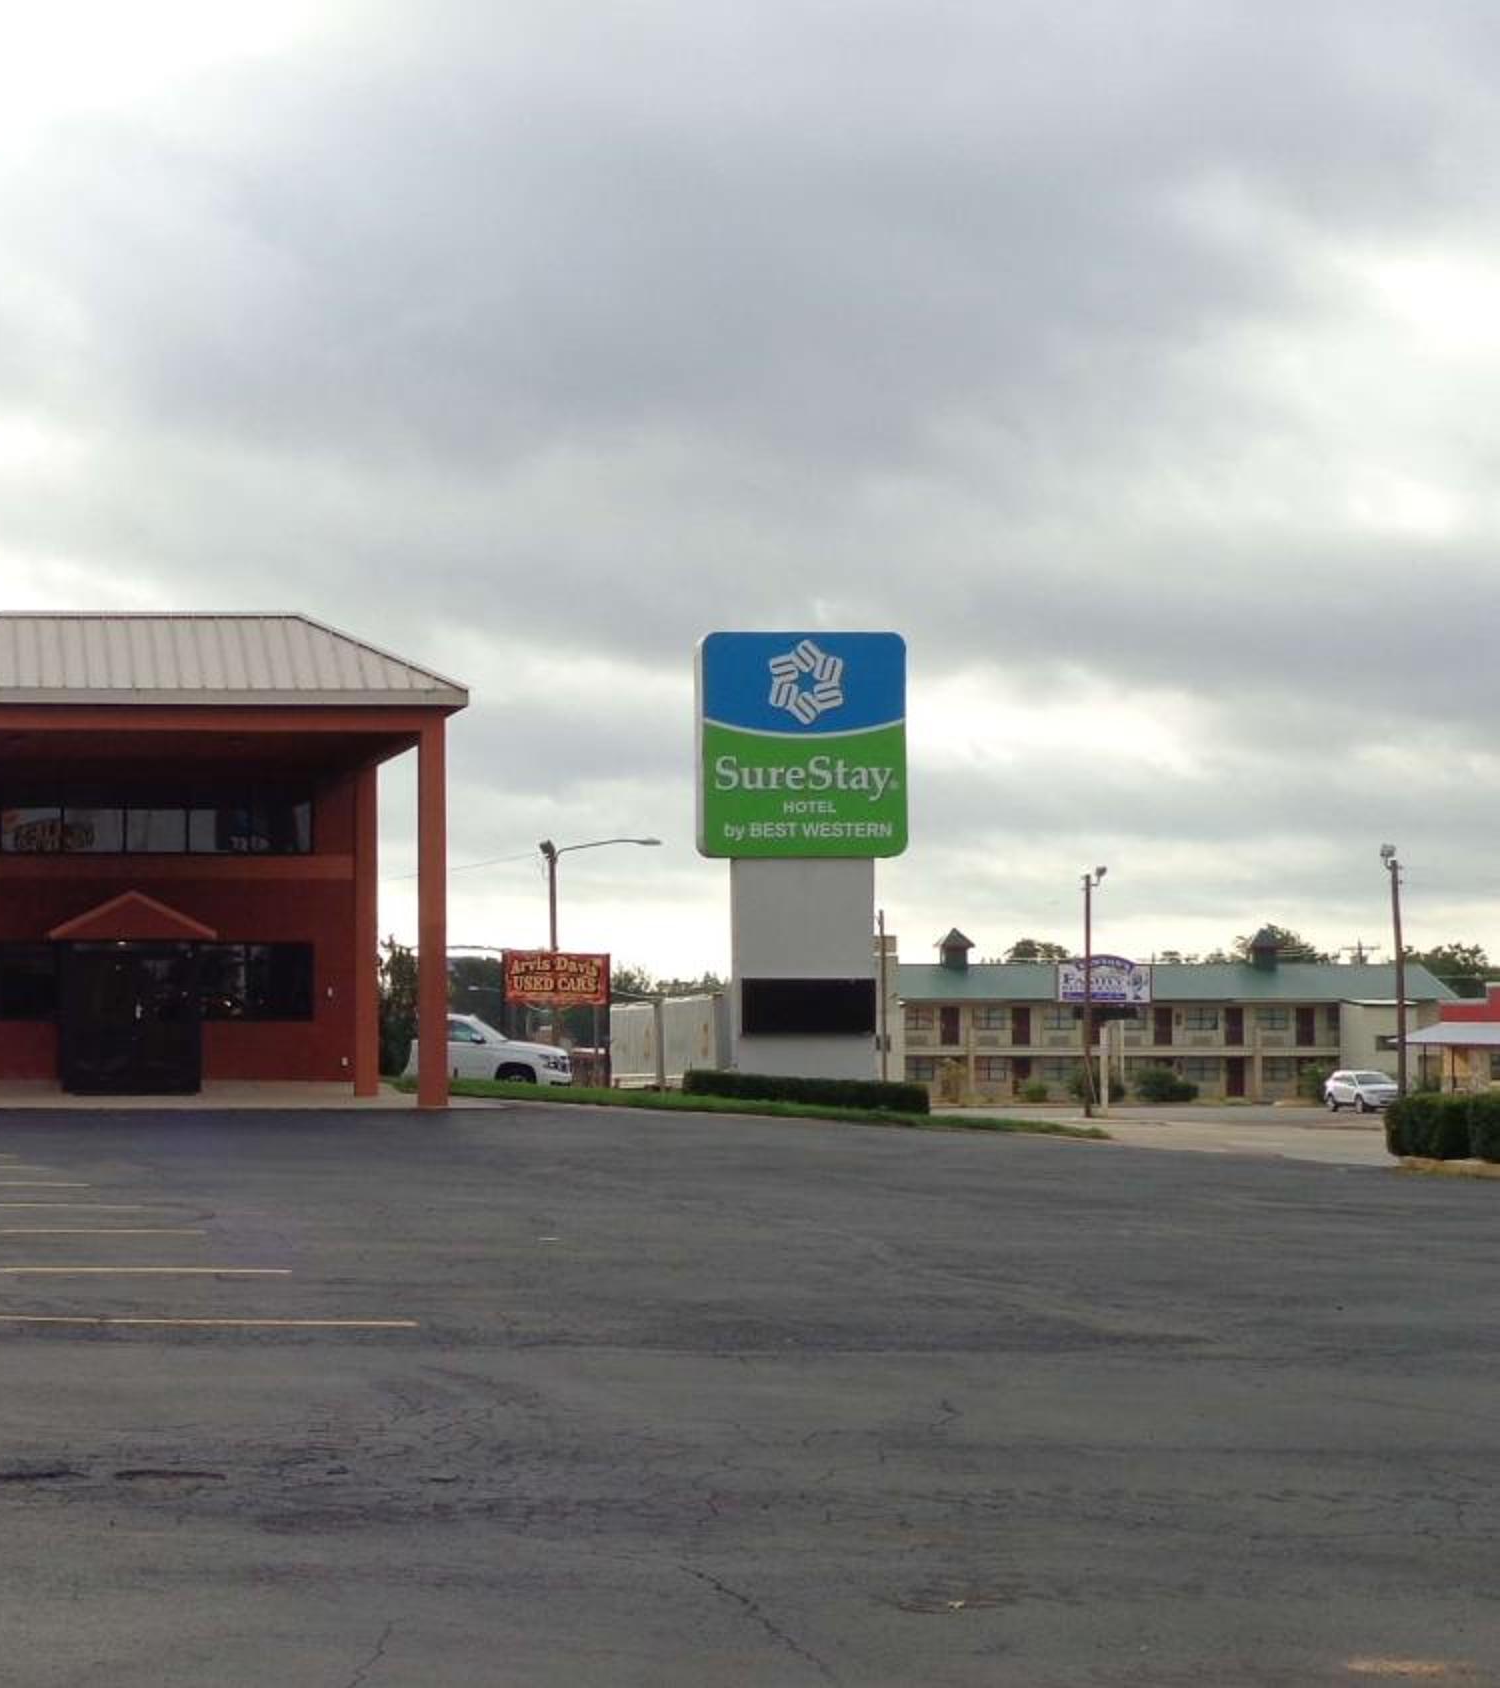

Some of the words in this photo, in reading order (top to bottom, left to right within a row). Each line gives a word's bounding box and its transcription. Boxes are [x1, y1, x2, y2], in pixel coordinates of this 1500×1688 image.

[715, 756, 892, 801] SureStay
[783, 801, 837, 814] HOTEL
[724, 824, 745, 841] by
[749, 823, 797, 838] BEST
[803, 823, 892, 838] WESTERN
[513, 976, 555, 991] USED
[557, 976, 598, 992] CARS
